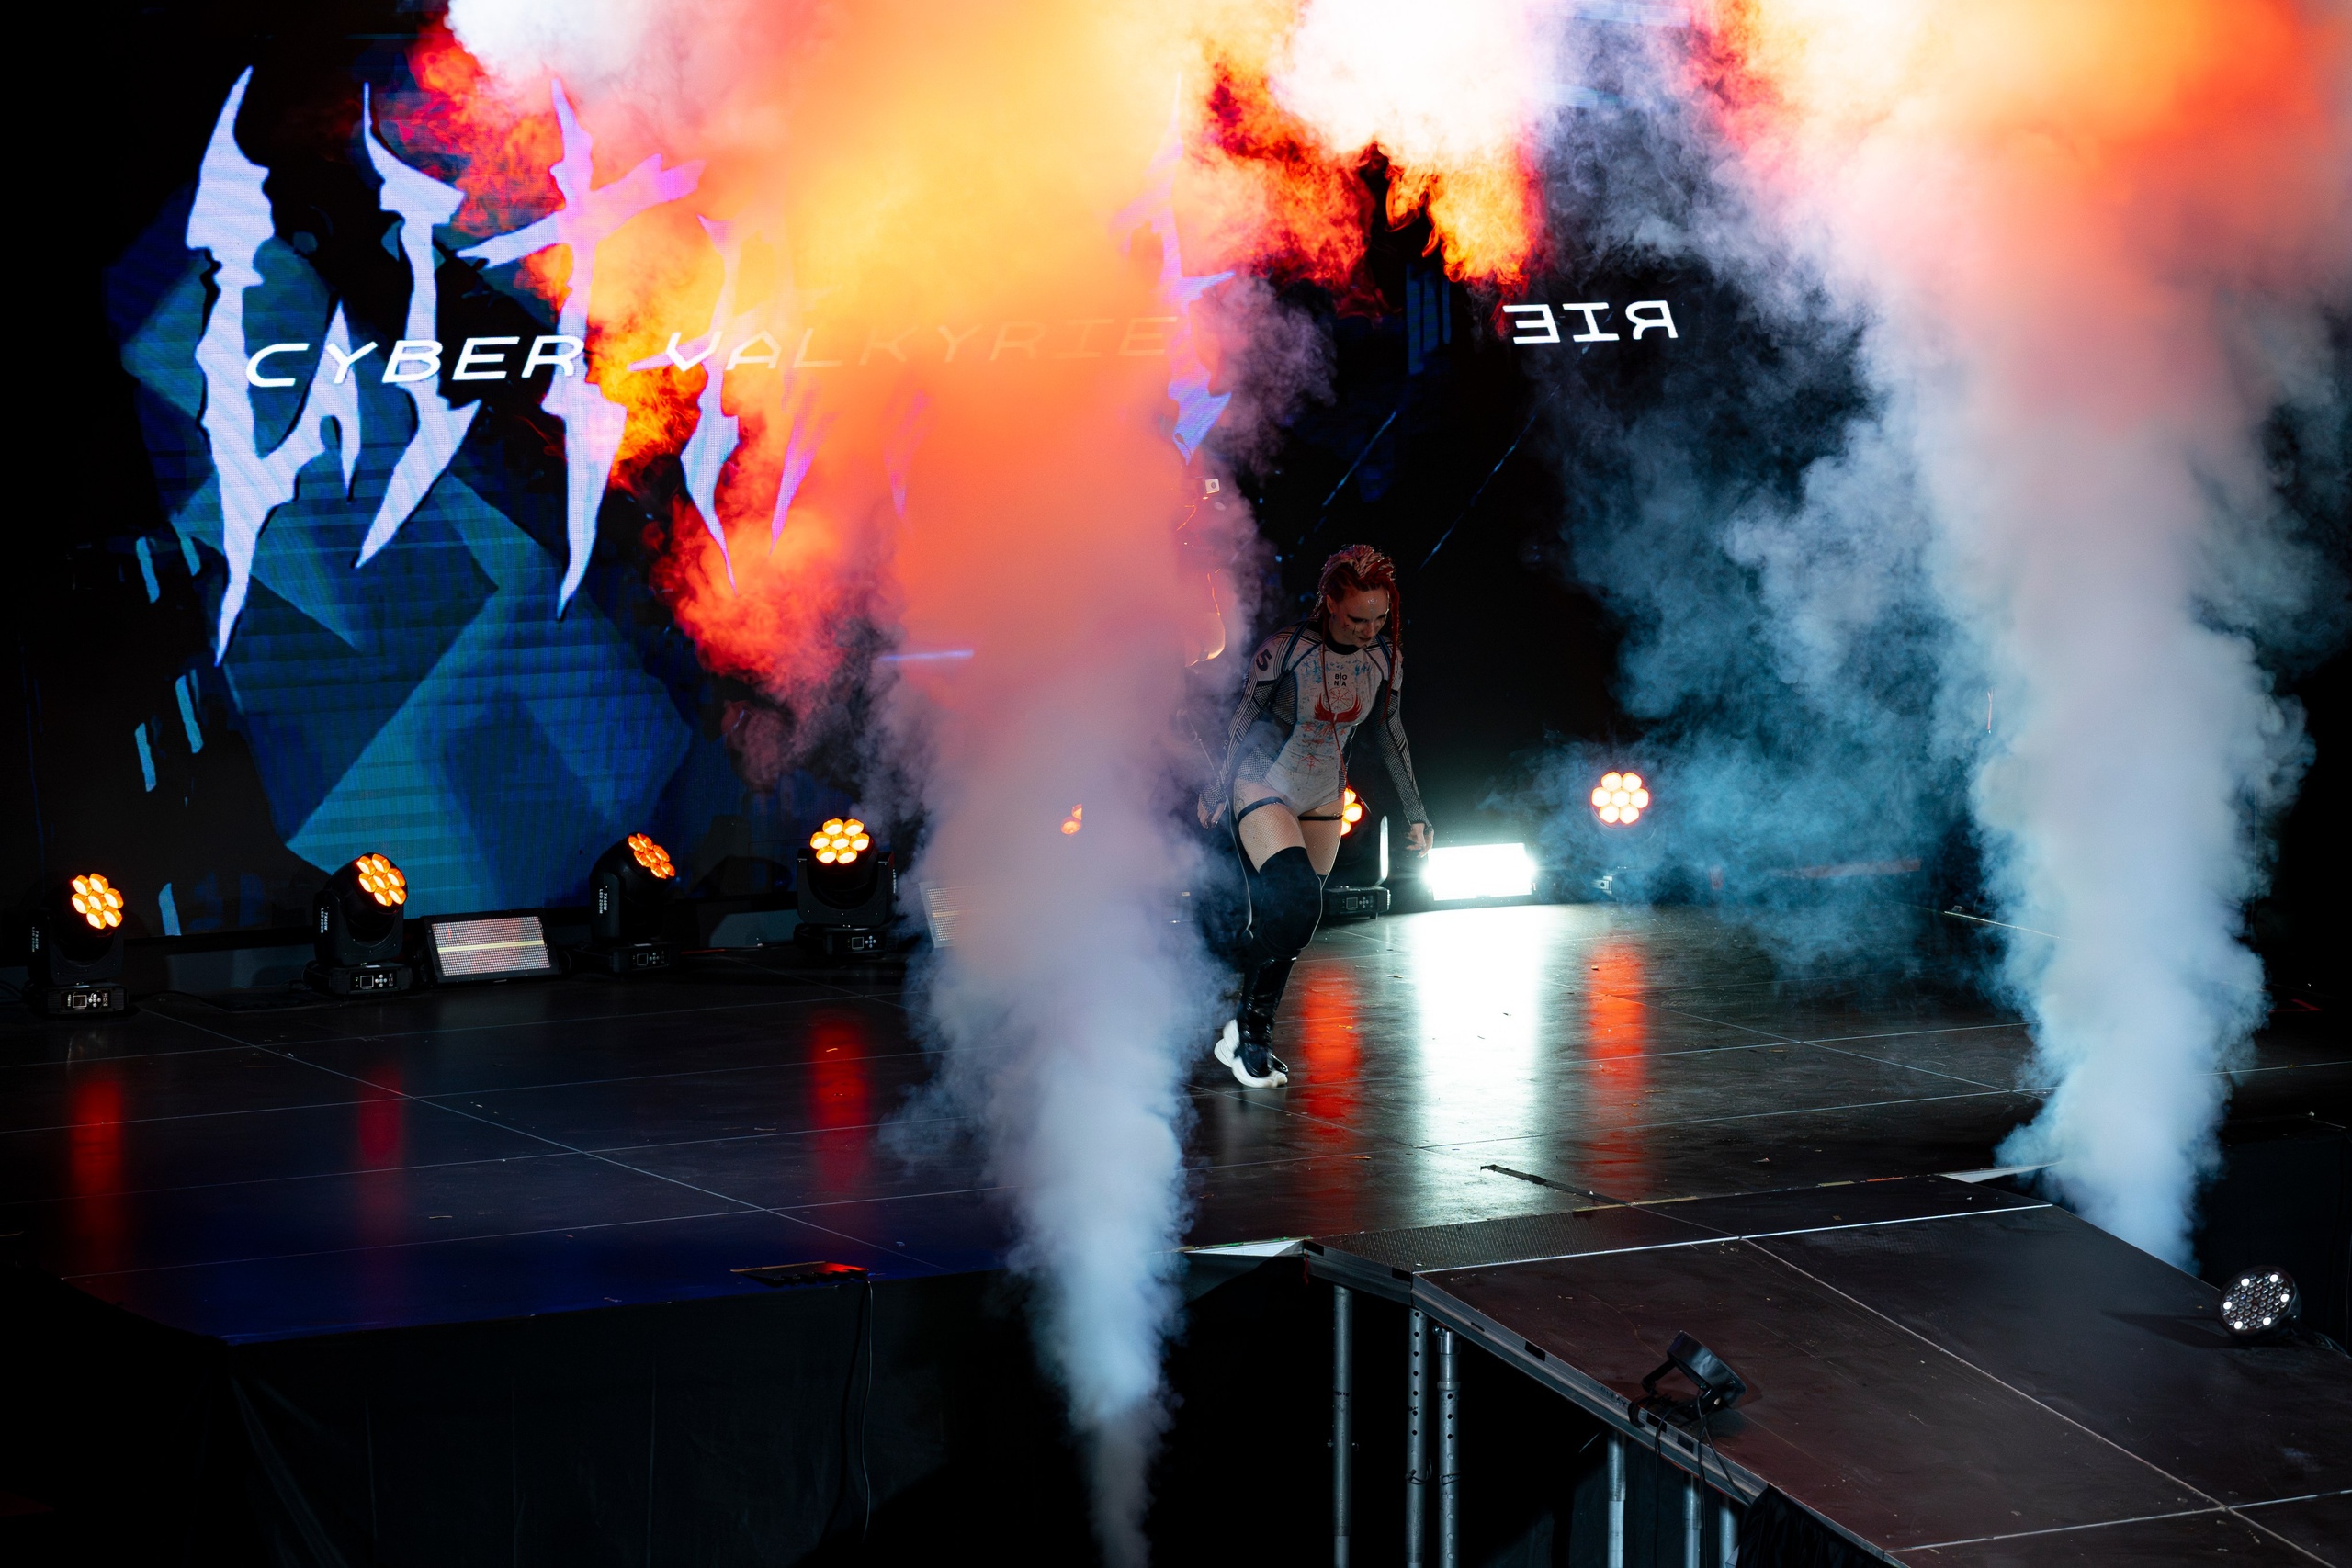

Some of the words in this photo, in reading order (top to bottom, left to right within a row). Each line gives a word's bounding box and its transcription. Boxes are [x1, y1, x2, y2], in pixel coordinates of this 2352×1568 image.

[245, 335, 585, 388] CYBER
[665, 316, 1178, 372] VALKYRIE
[1256, 649, 1272, 671] 5
